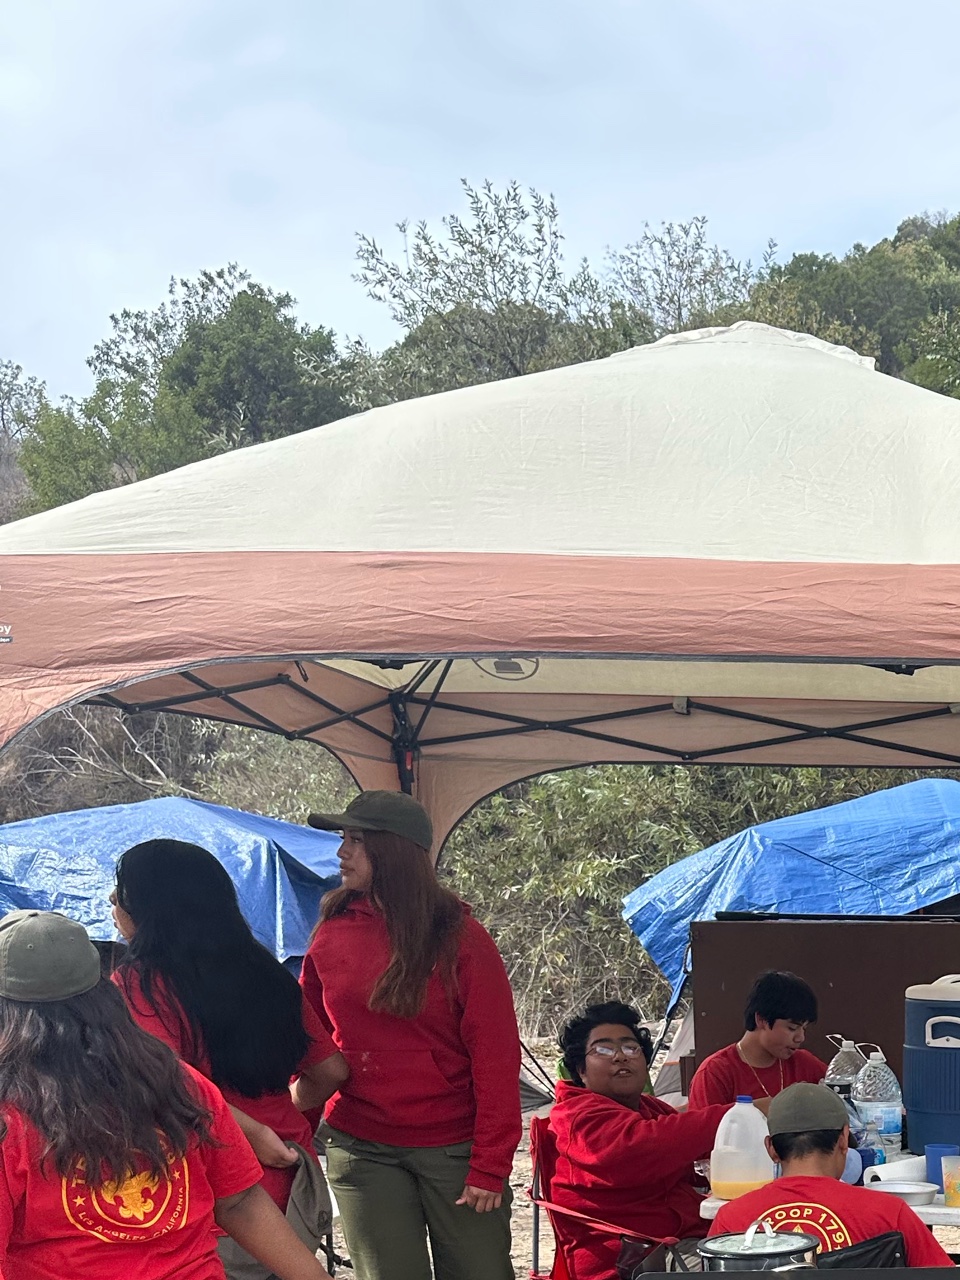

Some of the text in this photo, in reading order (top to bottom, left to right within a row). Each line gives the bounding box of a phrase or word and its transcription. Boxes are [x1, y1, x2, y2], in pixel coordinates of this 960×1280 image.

[153, 1187, 184, 1238] CALIFORNIA
[764, 1208, 845, 1243] ROOP 179
